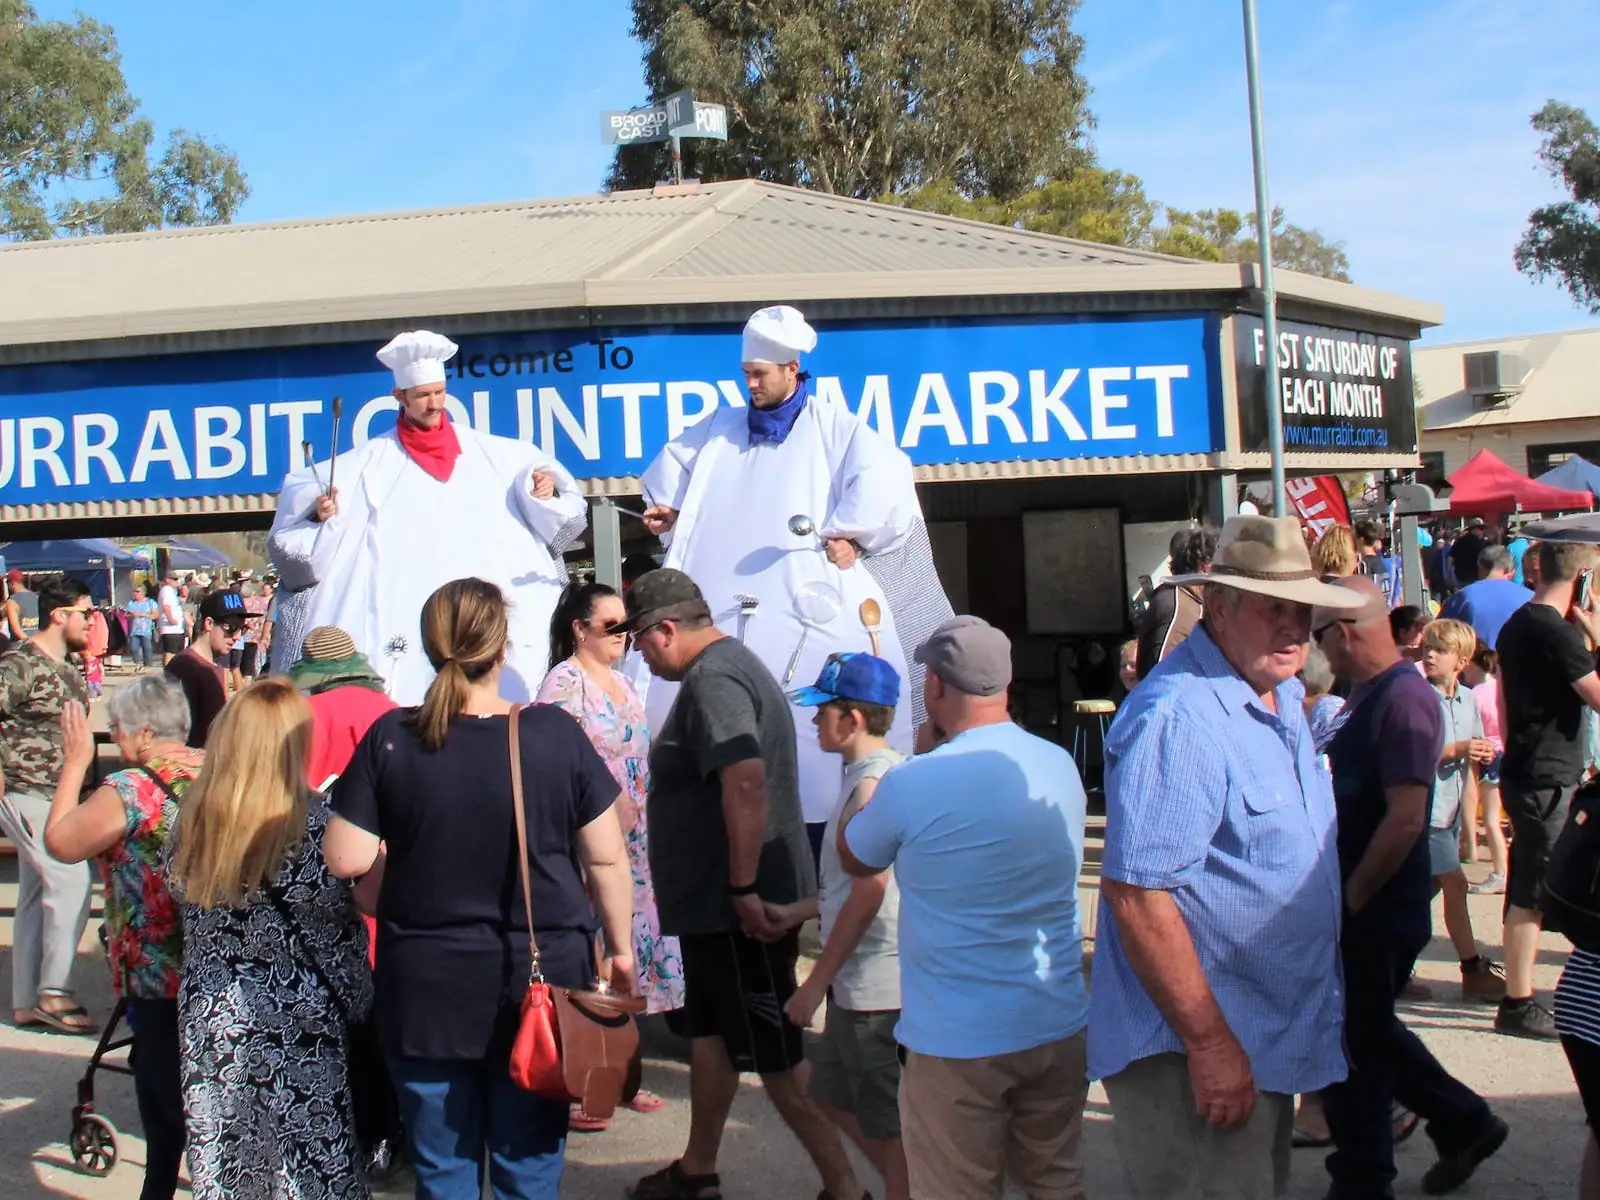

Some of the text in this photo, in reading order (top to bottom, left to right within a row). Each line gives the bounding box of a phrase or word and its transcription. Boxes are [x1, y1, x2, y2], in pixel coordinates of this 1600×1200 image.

[610, 111, 667, 128] BROAD
[618, 123, 662, 139] CAST
[446, 338, 634, 380] lcome To
[1253, 328, 1397, 380] FST SATURDAY OF
[816, 364, 1189, 448] MARKET
[1281, 377, 1383, 418] EACH MONTH
